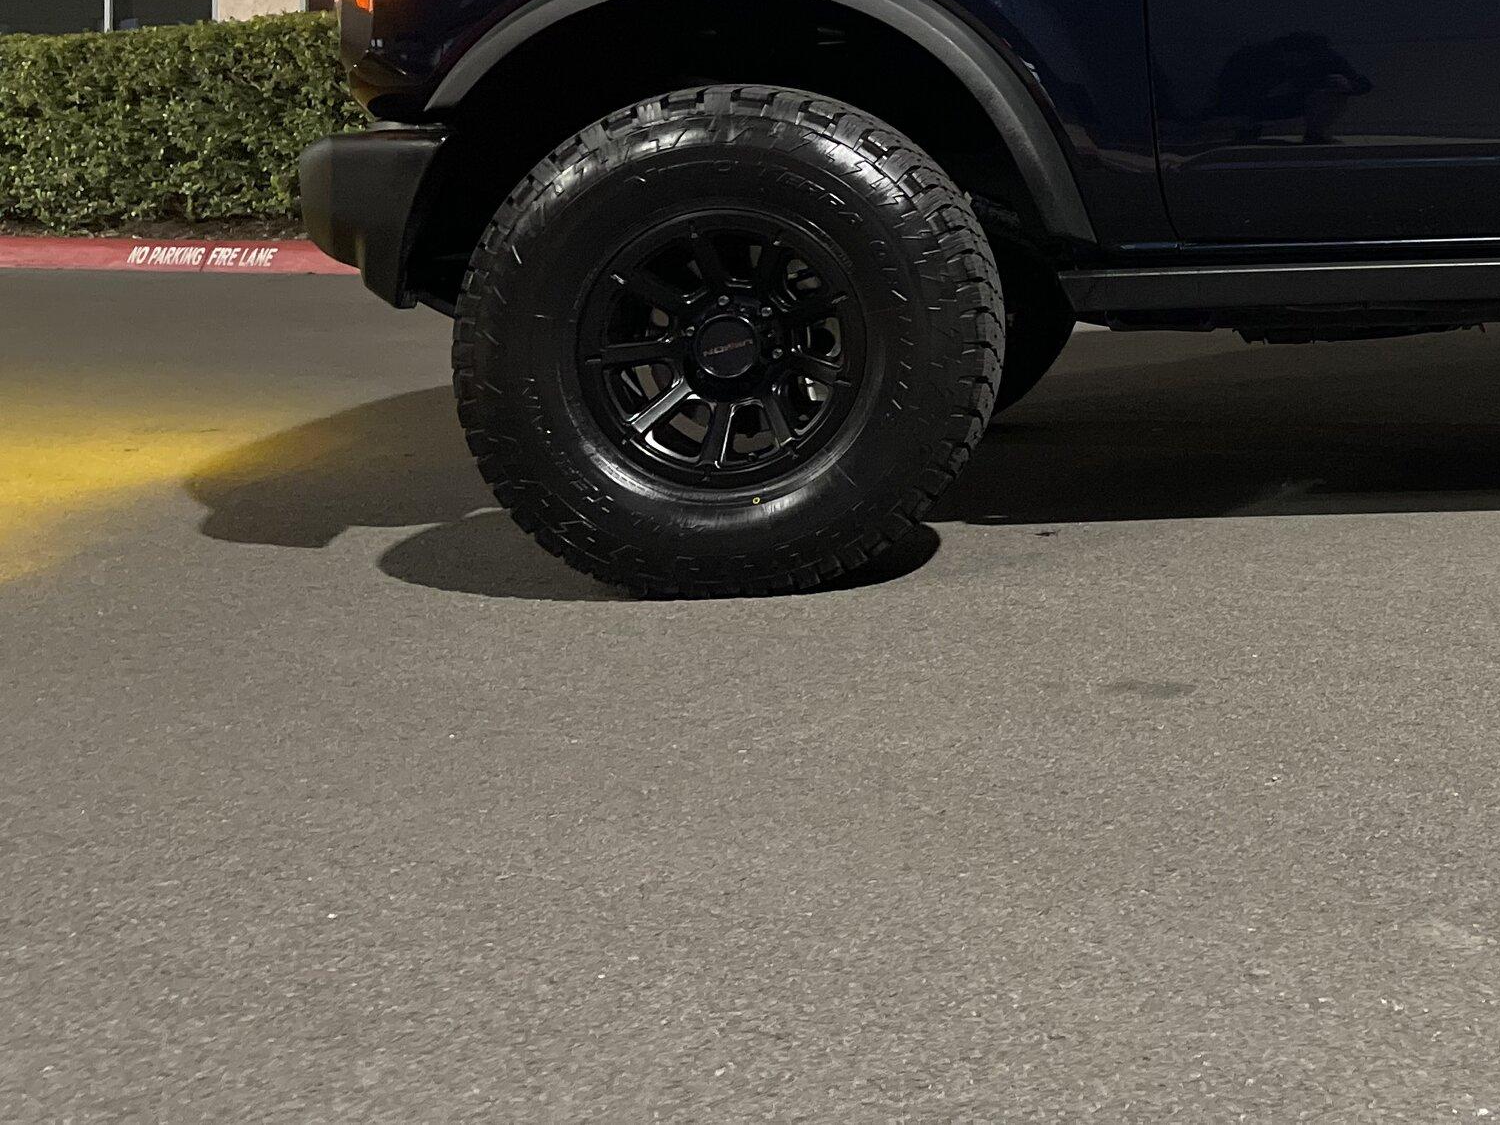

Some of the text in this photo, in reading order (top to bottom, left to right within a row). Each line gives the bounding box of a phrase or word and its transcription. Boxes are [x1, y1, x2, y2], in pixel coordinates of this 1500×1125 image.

[127, 246, 279, 267] NO PARKING FIRE LANE
